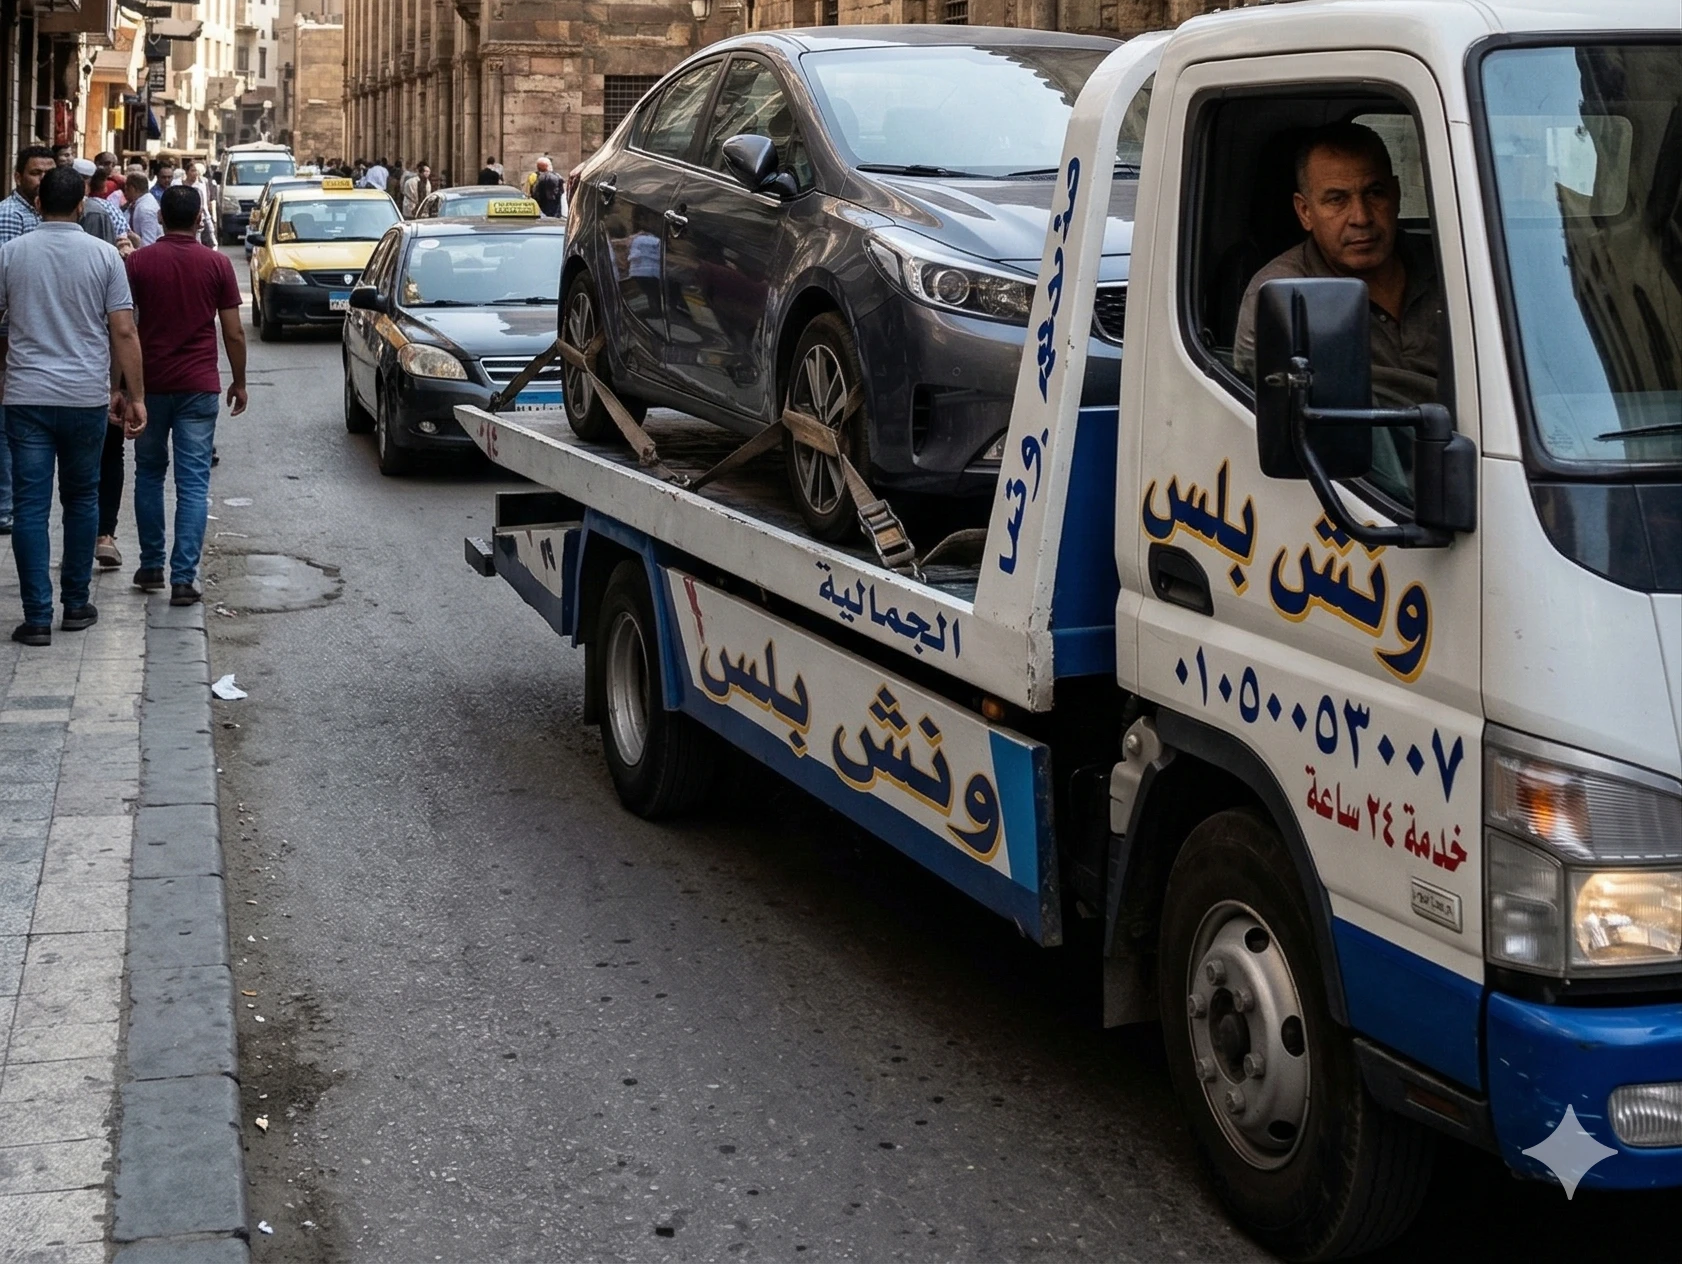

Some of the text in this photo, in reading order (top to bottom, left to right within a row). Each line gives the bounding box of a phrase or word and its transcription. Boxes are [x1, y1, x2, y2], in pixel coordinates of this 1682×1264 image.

[815, 559, 960, 660] الجمالية
[1141, 456, 1434, 684] ونش بلس
[699, 638, 1003, 864] ونش بلس
[1175, 644, 1464, 803] ٠١٠٥٠٠٥٣٠٠٧
[1304, 764, 1469, 873] خدمة ٢٤ ساعة
